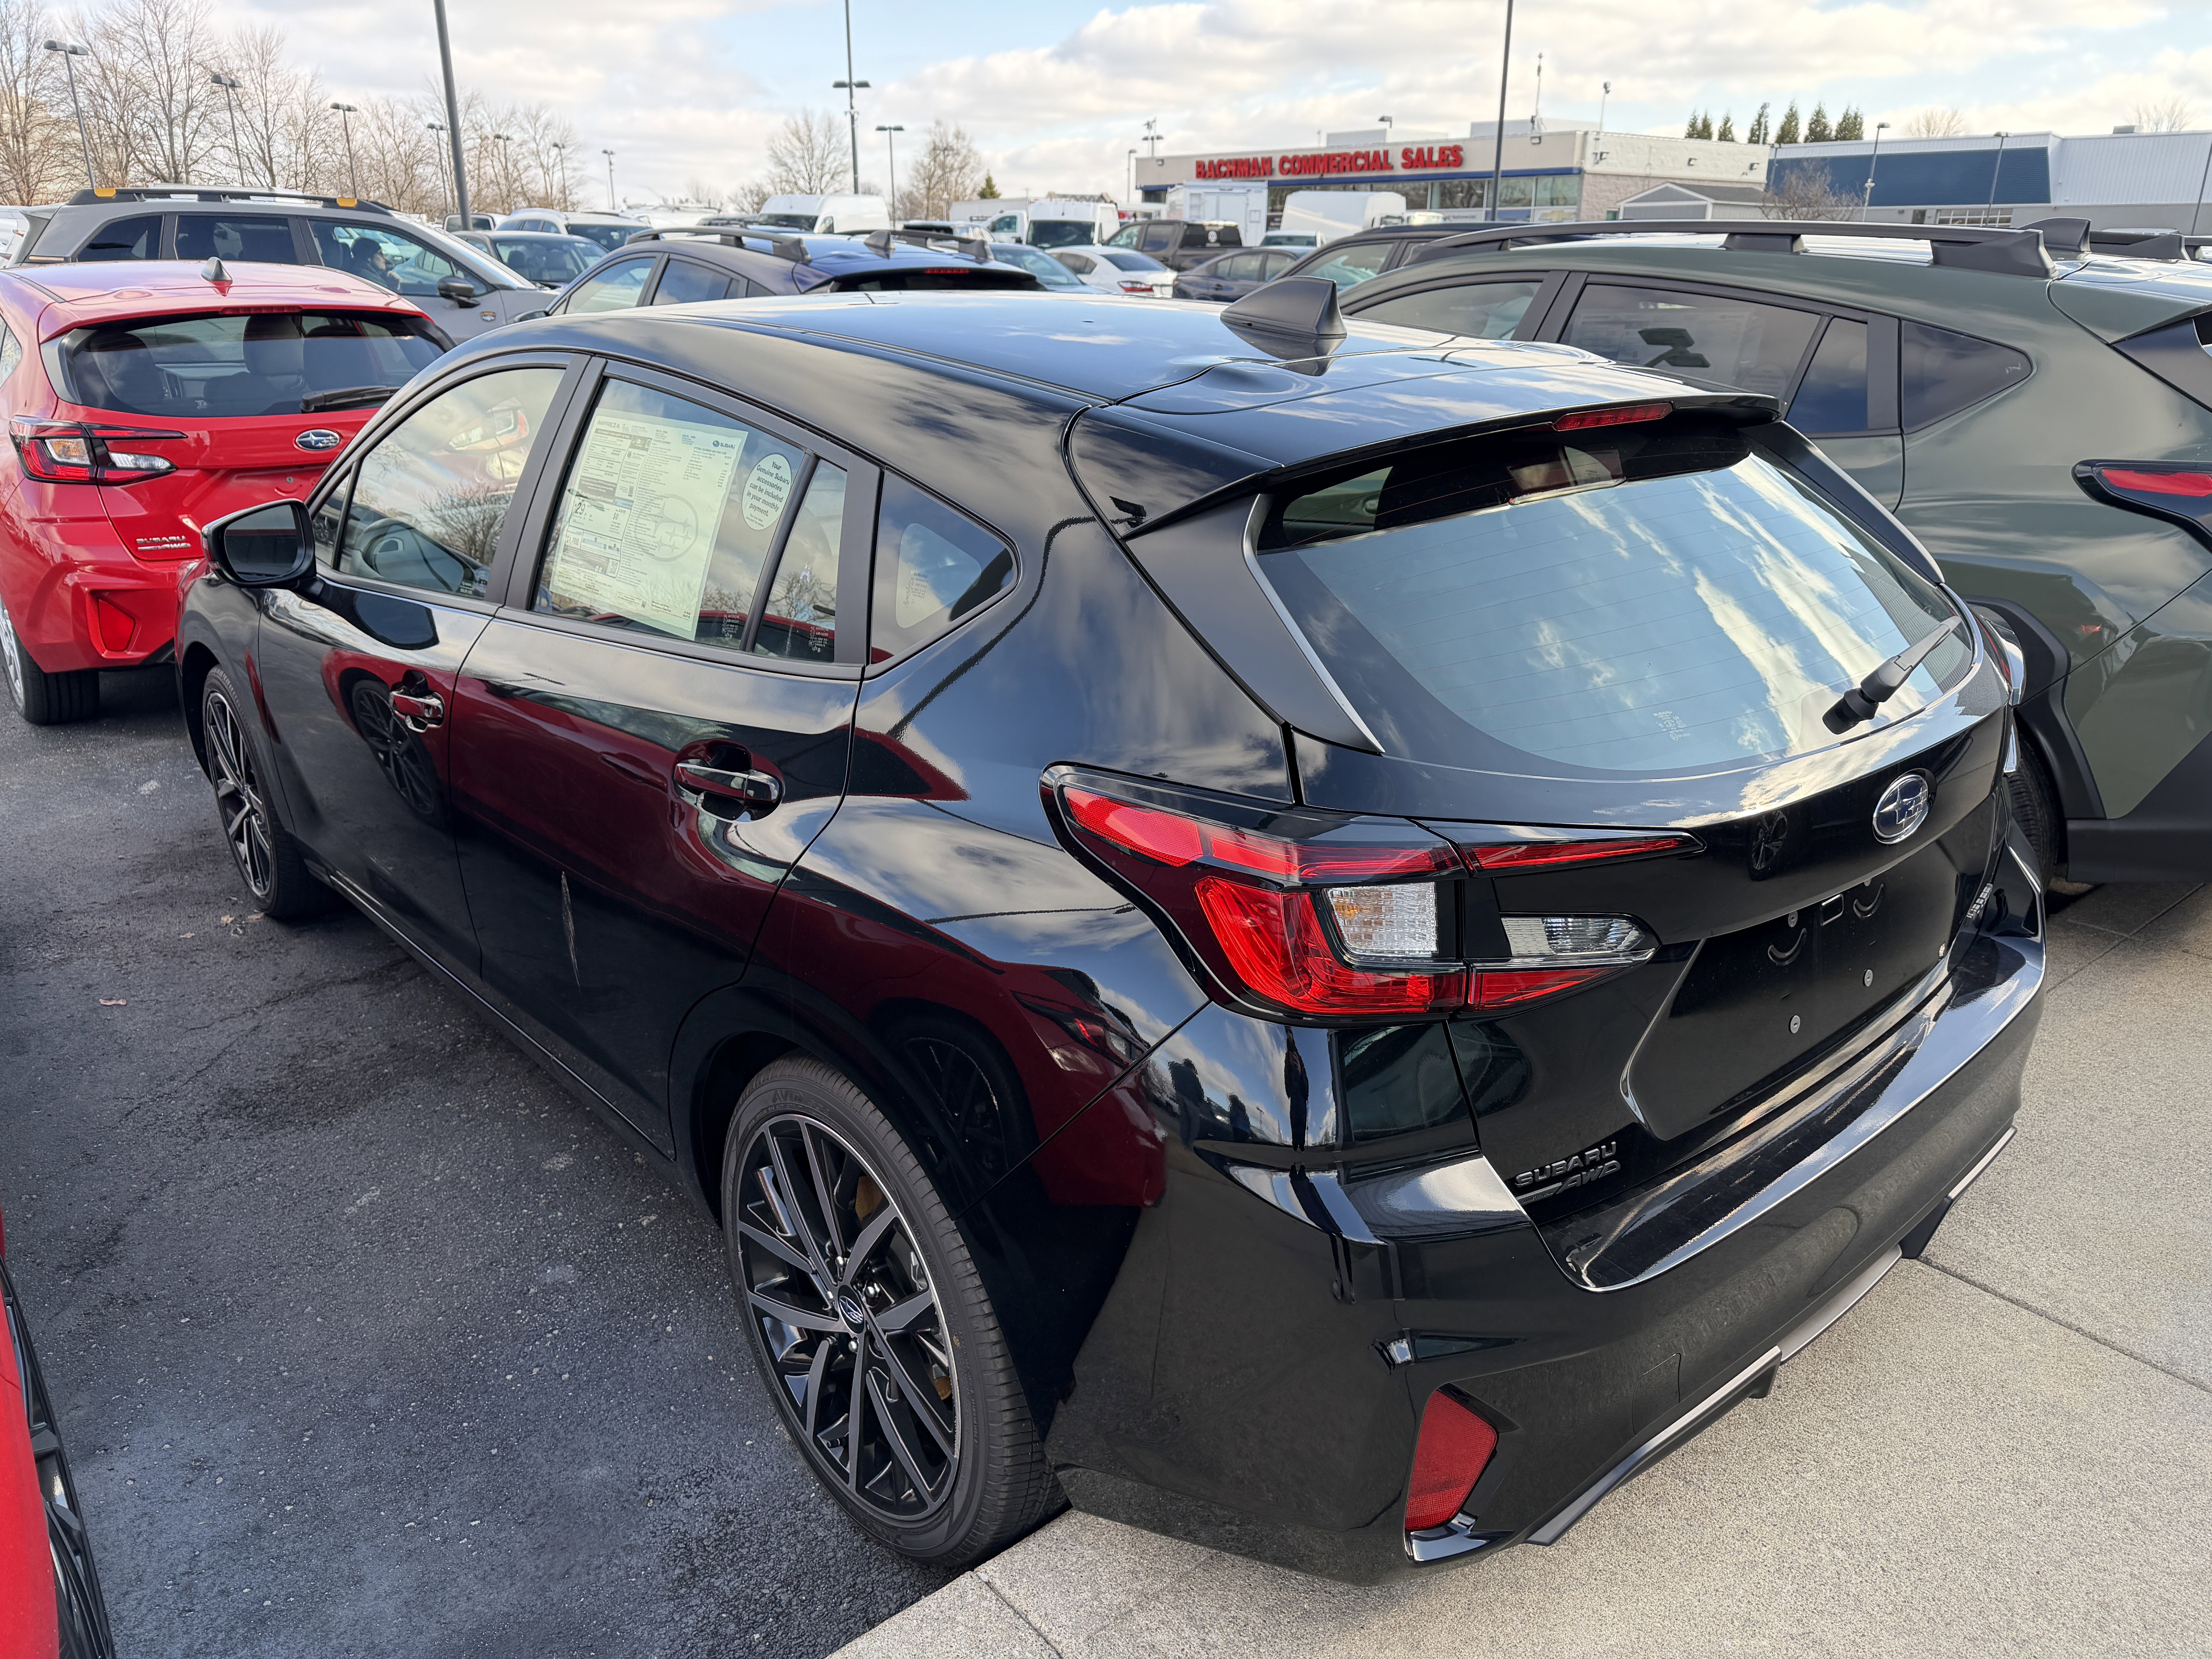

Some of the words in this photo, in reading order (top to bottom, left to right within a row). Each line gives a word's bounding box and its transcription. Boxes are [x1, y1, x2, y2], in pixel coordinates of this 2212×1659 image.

[1196, 156, 1272, 179] BACHMAN
[1279, 149, 1393, 175] COMMERCIAL
[1401, 144, 1463, 169] SALES
[597, 420, 620, 428] IMPREZA
[756, 464, 774, 477] Genuine
[774, 473, 790, 485] Subaru
[771, 461, 782, 471] Your
[757, 476, 782, 492] accessories
[750, 483, 758, 491] can
[764, 488, 784, 503] included
[575, 502, 586, 515] 29
[749, 503, 769, 517] payment.
[751, 494, 762, 502] your
[762, 499, 780, 512] monthly
[136, 535, 186, 543] SUBARU
[1515, 1141, 1616, 1187] SUBARU
[1556, 1160, 1621, 1194] AWD
